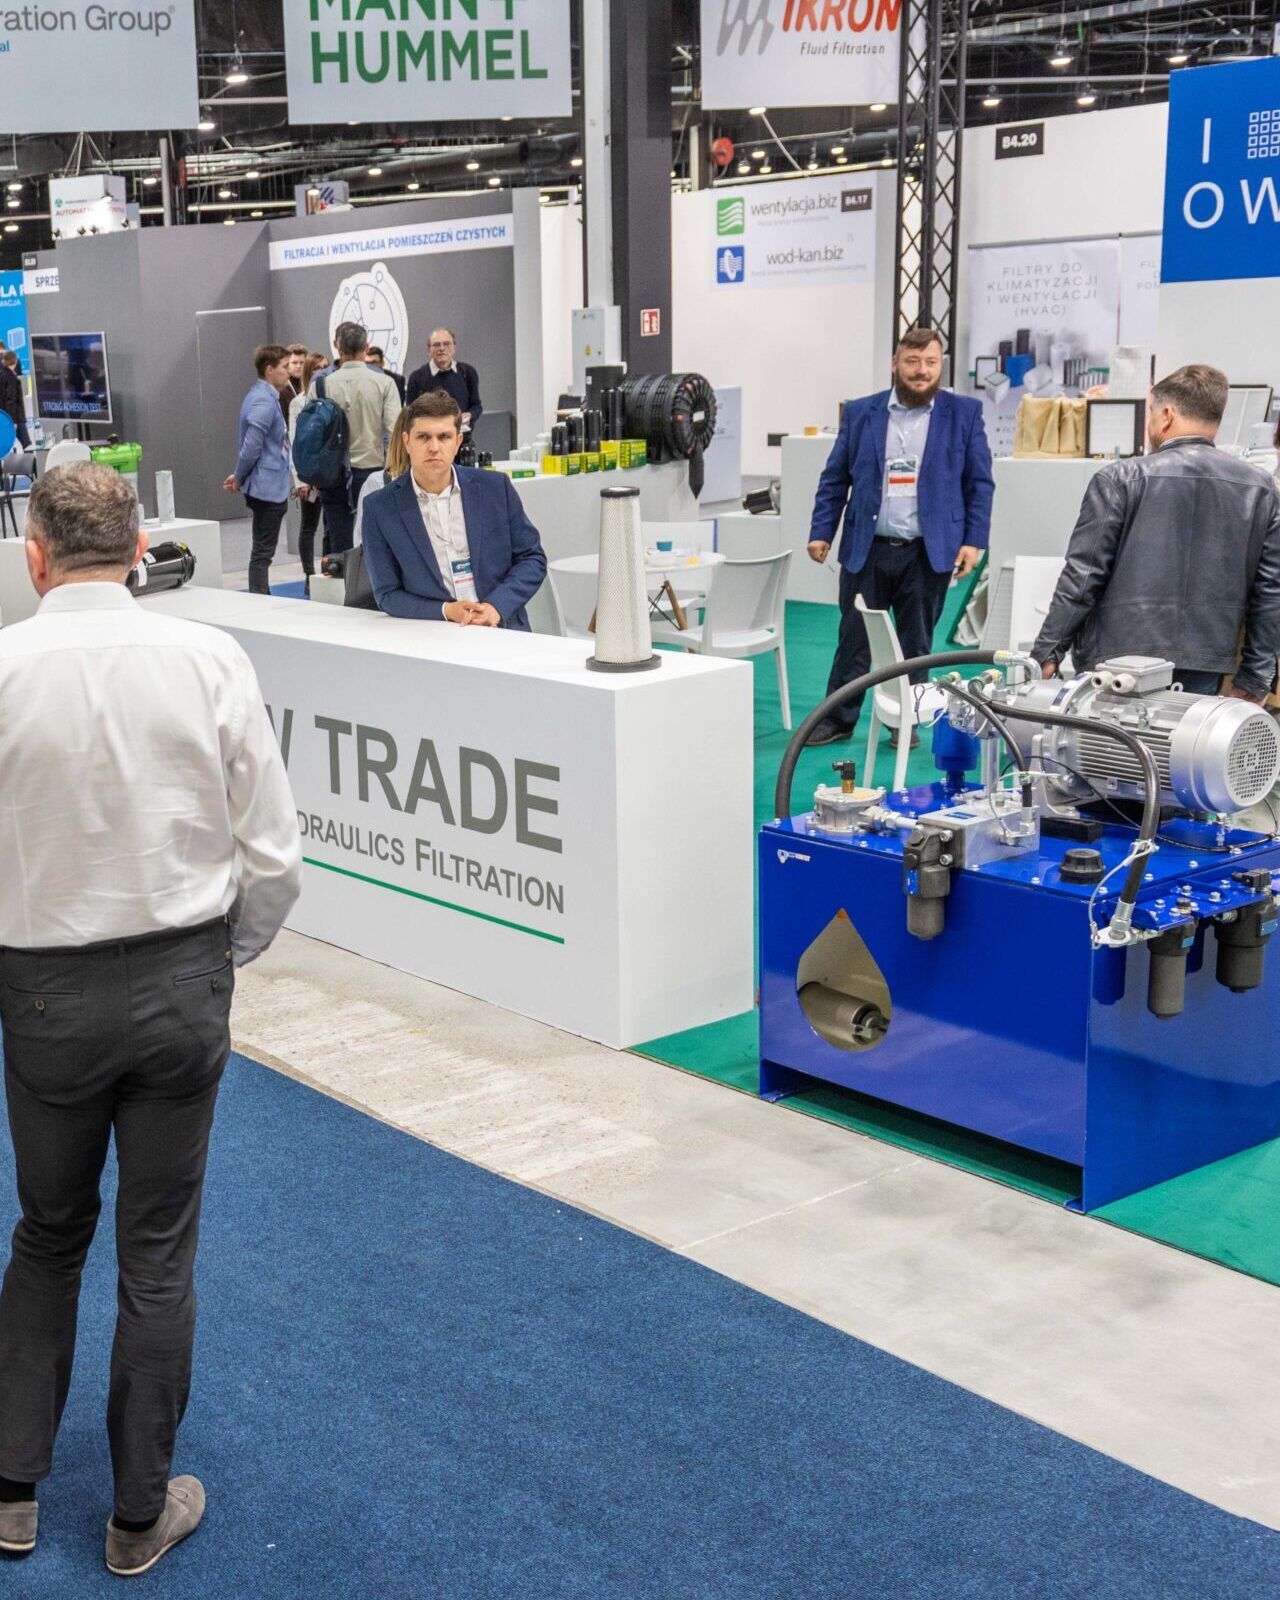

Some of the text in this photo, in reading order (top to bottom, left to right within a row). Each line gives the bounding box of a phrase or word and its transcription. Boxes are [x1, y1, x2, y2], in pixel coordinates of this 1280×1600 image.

[85, 4, 170, 37] Group
[782, 0, 901, 32] IKRON
[311, 30, 548, 84] HUMMEL
[800, 41, 886, 55] Fluid Filtration
[1002, 132, 1037, 149] B4.20
[750, 193, 838, 217] wentylacja.biz
[845, 194, 868, 206] B4.17
[284, 225, 505, 260] FILTRACJA I WENTYLACJA POMIESZCZEŃ CZYSTYCH
[766, 245, 844, 265] wod-kan.biz
[1003, 262, 1083, 277] FILTRY DO
[987, 275, 1099, 292] KLIMATYZACJI
[998, 290, 1098, 304] WENTYLACJI
[1014, 304, 1067, 318] (HVAC)
[314, 714, 563, 854] TRADE
[296, 809, 565, 915] DRAULICS FILTRATION
